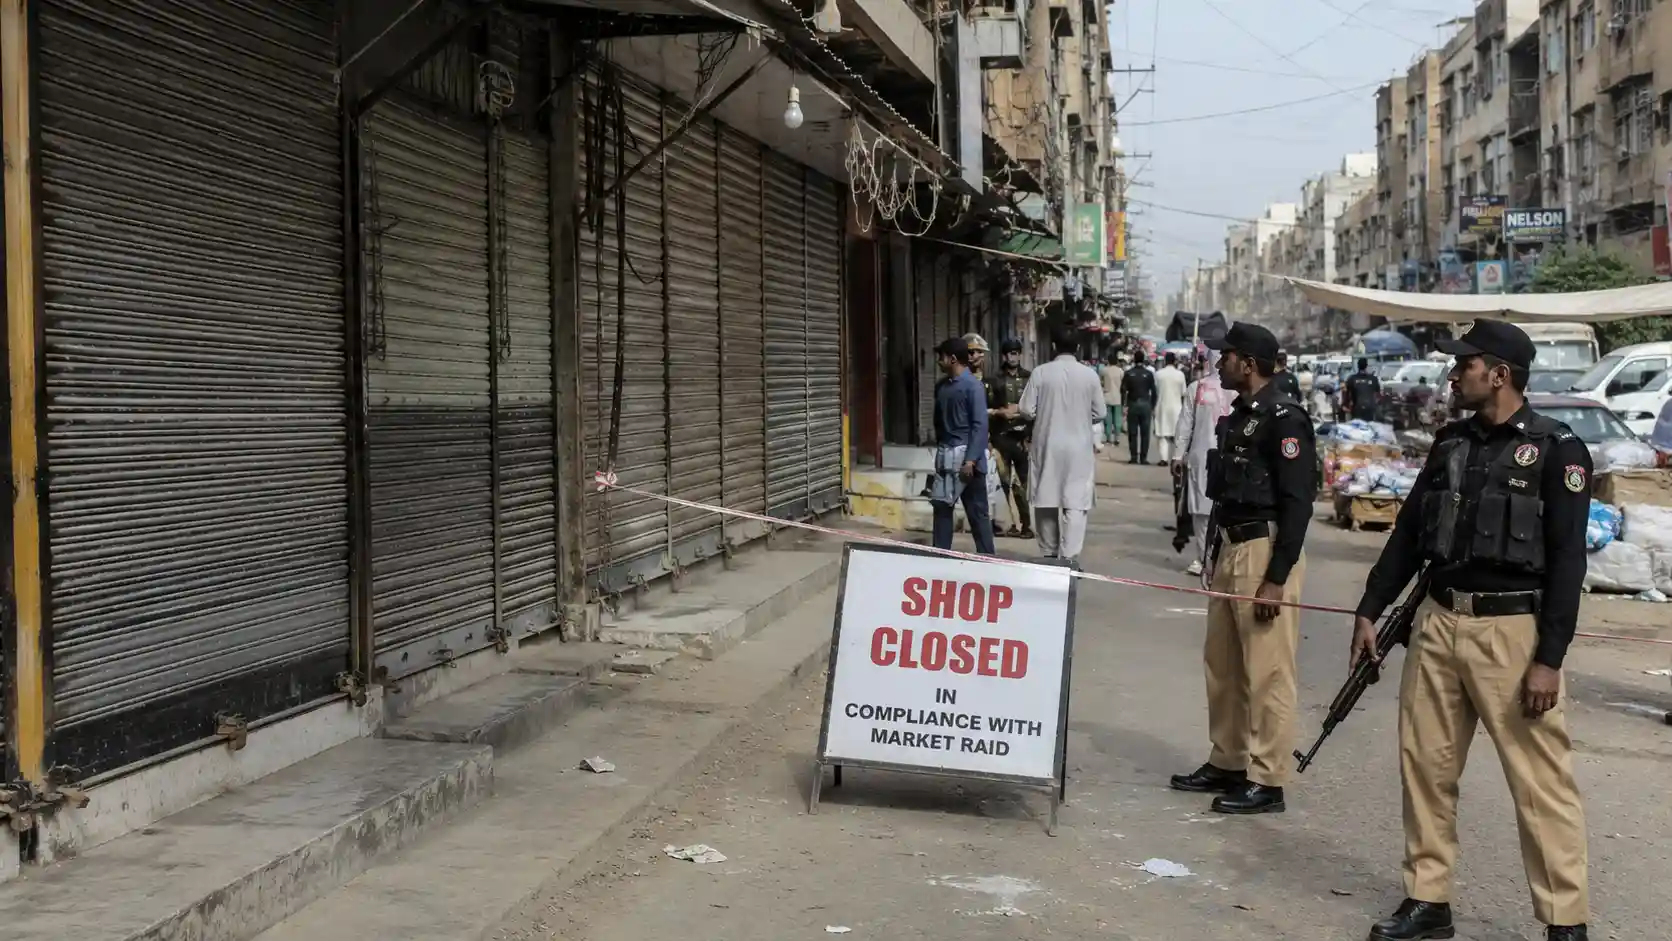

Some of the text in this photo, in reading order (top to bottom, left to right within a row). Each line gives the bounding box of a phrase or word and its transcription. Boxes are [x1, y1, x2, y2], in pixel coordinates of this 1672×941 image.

[1507, 211, 1562, 227] NELSON
[901, 576, 1013, 624] SHOP
[870, 626, 1029, 679] CLOSED
[935, 687, 957, 705] IN
[845, 702, 1042, 737] COMPLIANCE WITH
[870, 727, 1010, 756] MARKET RAID
